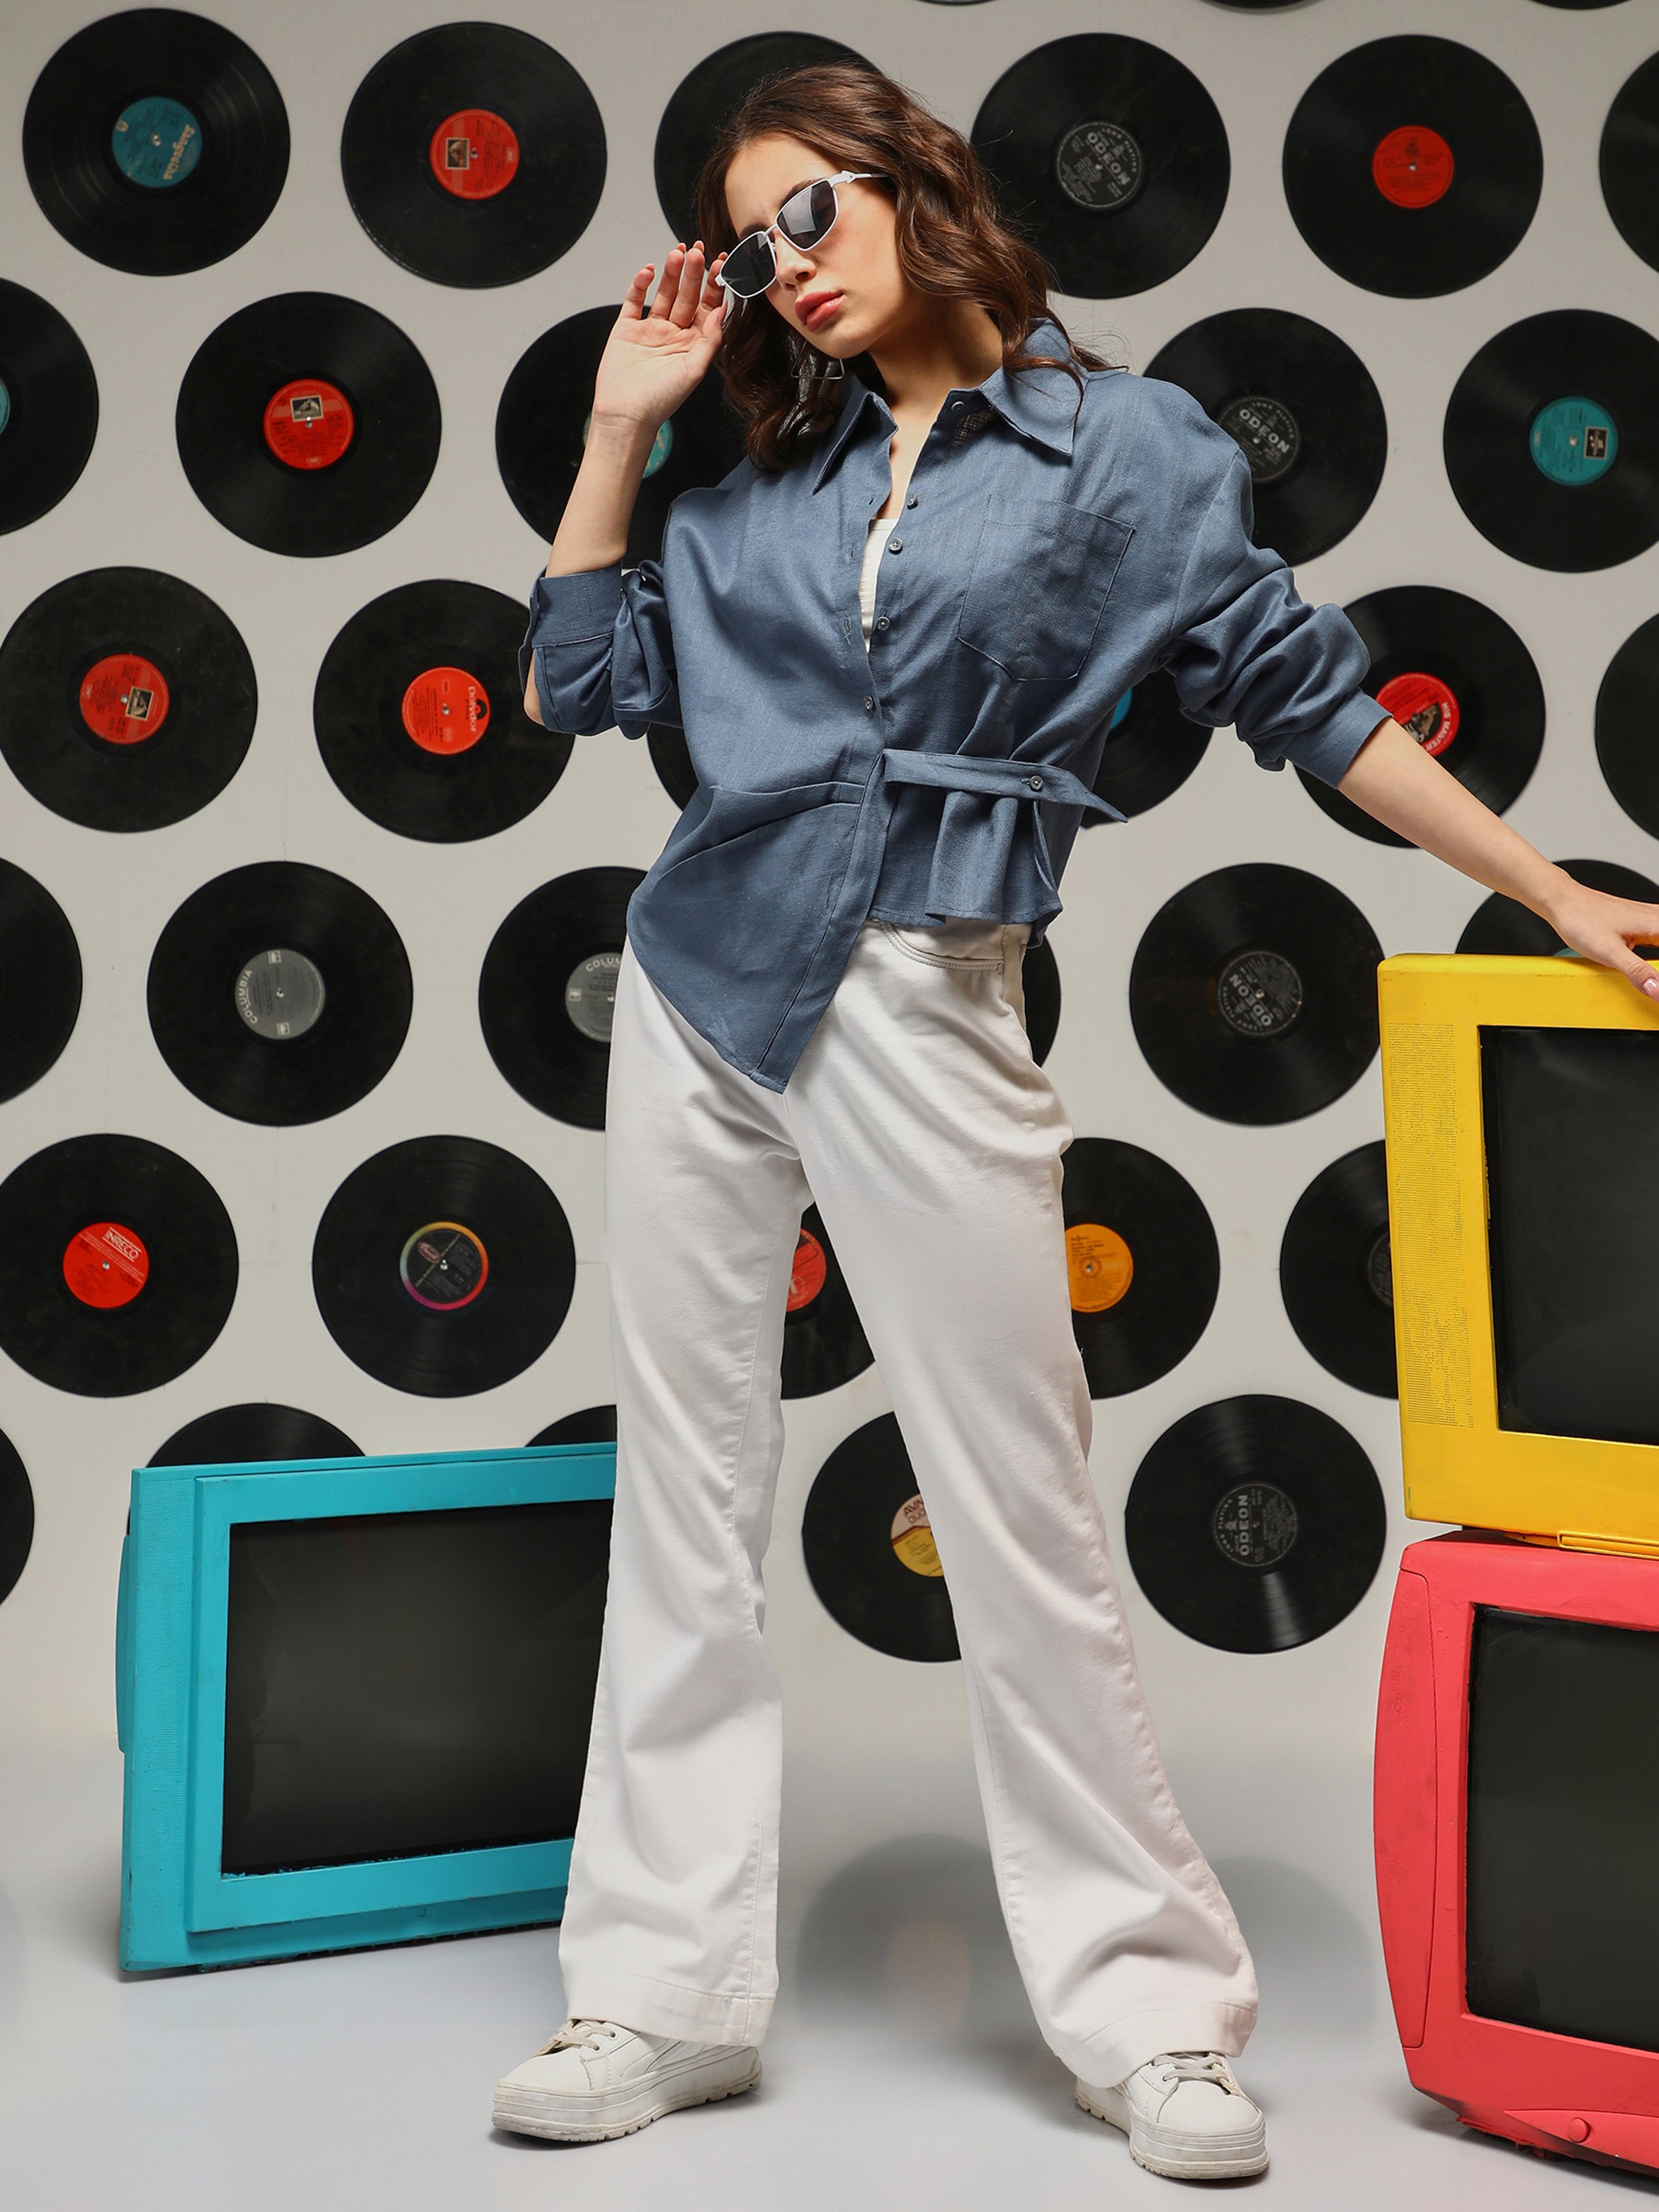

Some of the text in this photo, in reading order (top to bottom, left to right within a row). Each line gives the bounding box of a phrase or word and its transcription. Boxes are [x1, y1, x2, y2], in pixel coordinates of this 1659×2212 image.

[1087, 132, 1131, 185] ODEON
[1239, 409, 1290, 453] ODEON
[468, 686, 477, 732] Polydor
[239, 970, 258, 1024] COLUMBIA
[1229, 974, 1272, 1026] ODEON
[104, 1229, 139, 1259] INRECO
[1238, 1494, 1250, 1556] ODEON
